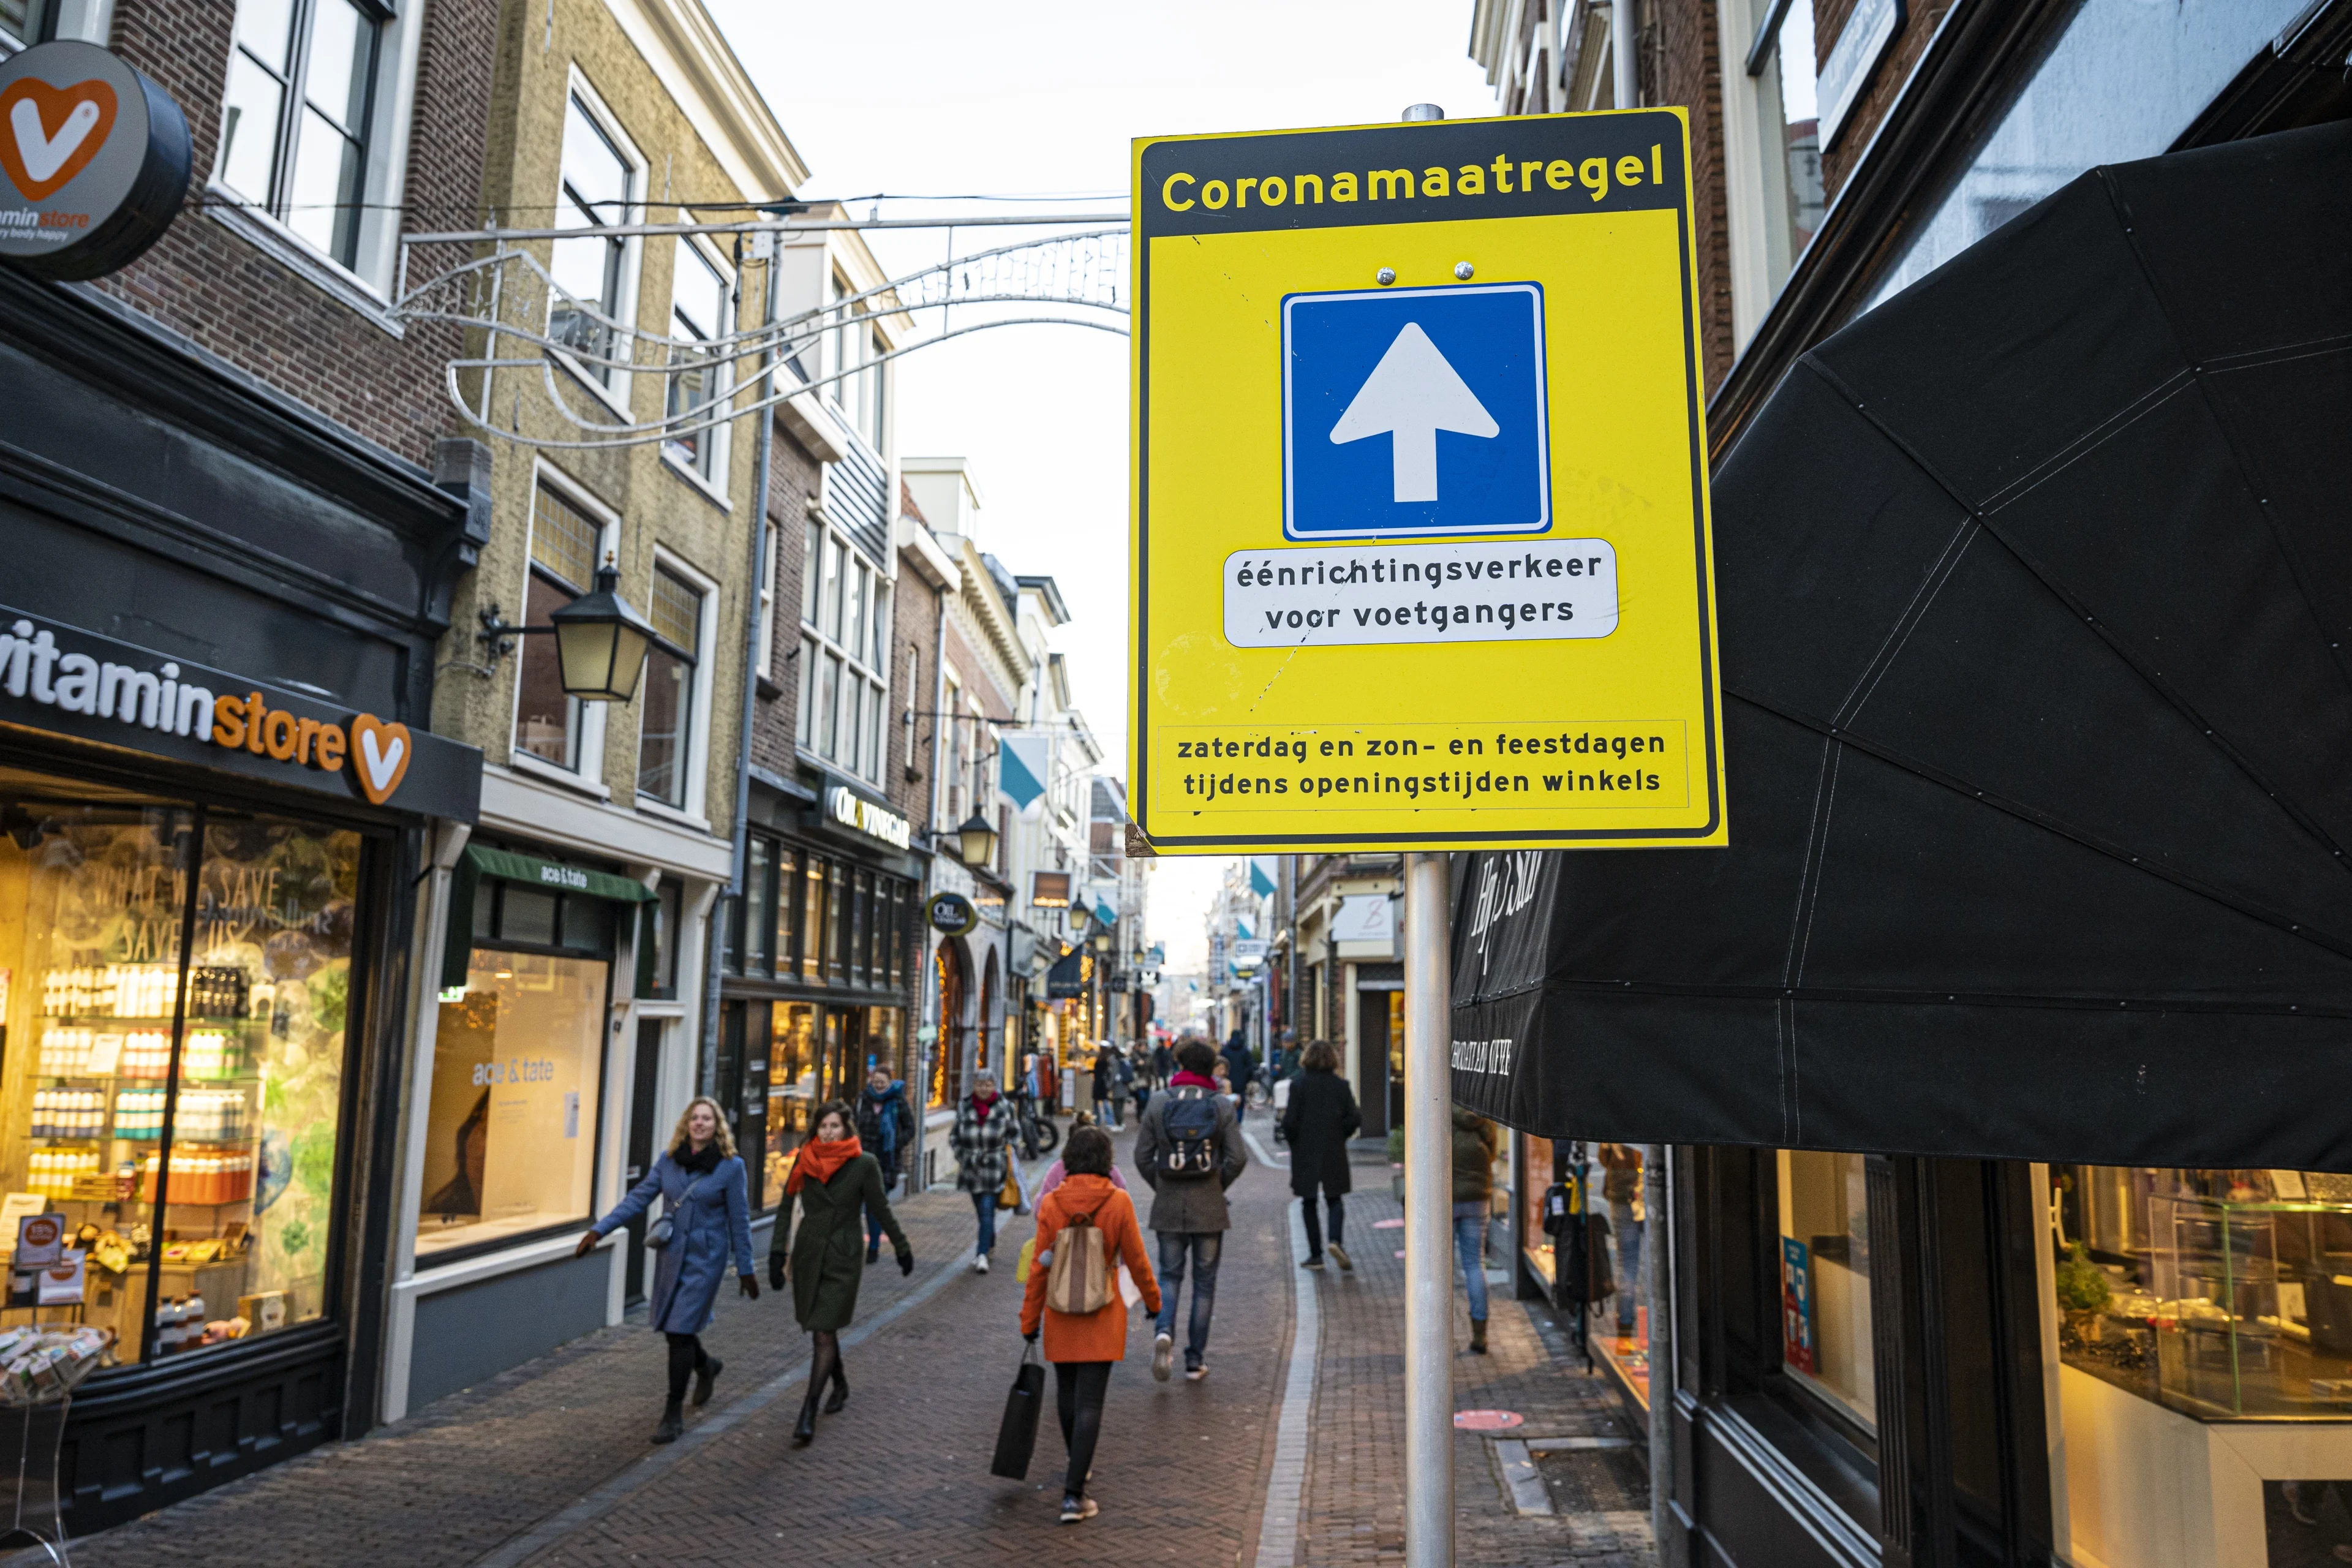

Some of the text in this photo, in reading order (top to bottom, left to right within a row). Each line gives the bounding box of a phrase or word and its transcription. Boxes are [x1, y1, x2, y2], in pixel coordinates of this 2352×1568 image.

[1162, 143, 1663, 212] Coronamaatregel
[0, 206, 90, 230] minstore
[1237, 553, 1602, 589] éénrichtingsverkeer
[1265, 601, 1574, 633] voor voetgangers
[1178, 732, 1664, 764] zaterdag en zon- en feestdagen
[1184, 769, 1660, 801] tijdens openingstijden winkels
[218, 866, 281, 910] SAVE
[120, 919, 239, 962] SAVE US
[473, 1062, 505, 1086] ace
[523, 1058, 554, 1082] tate
